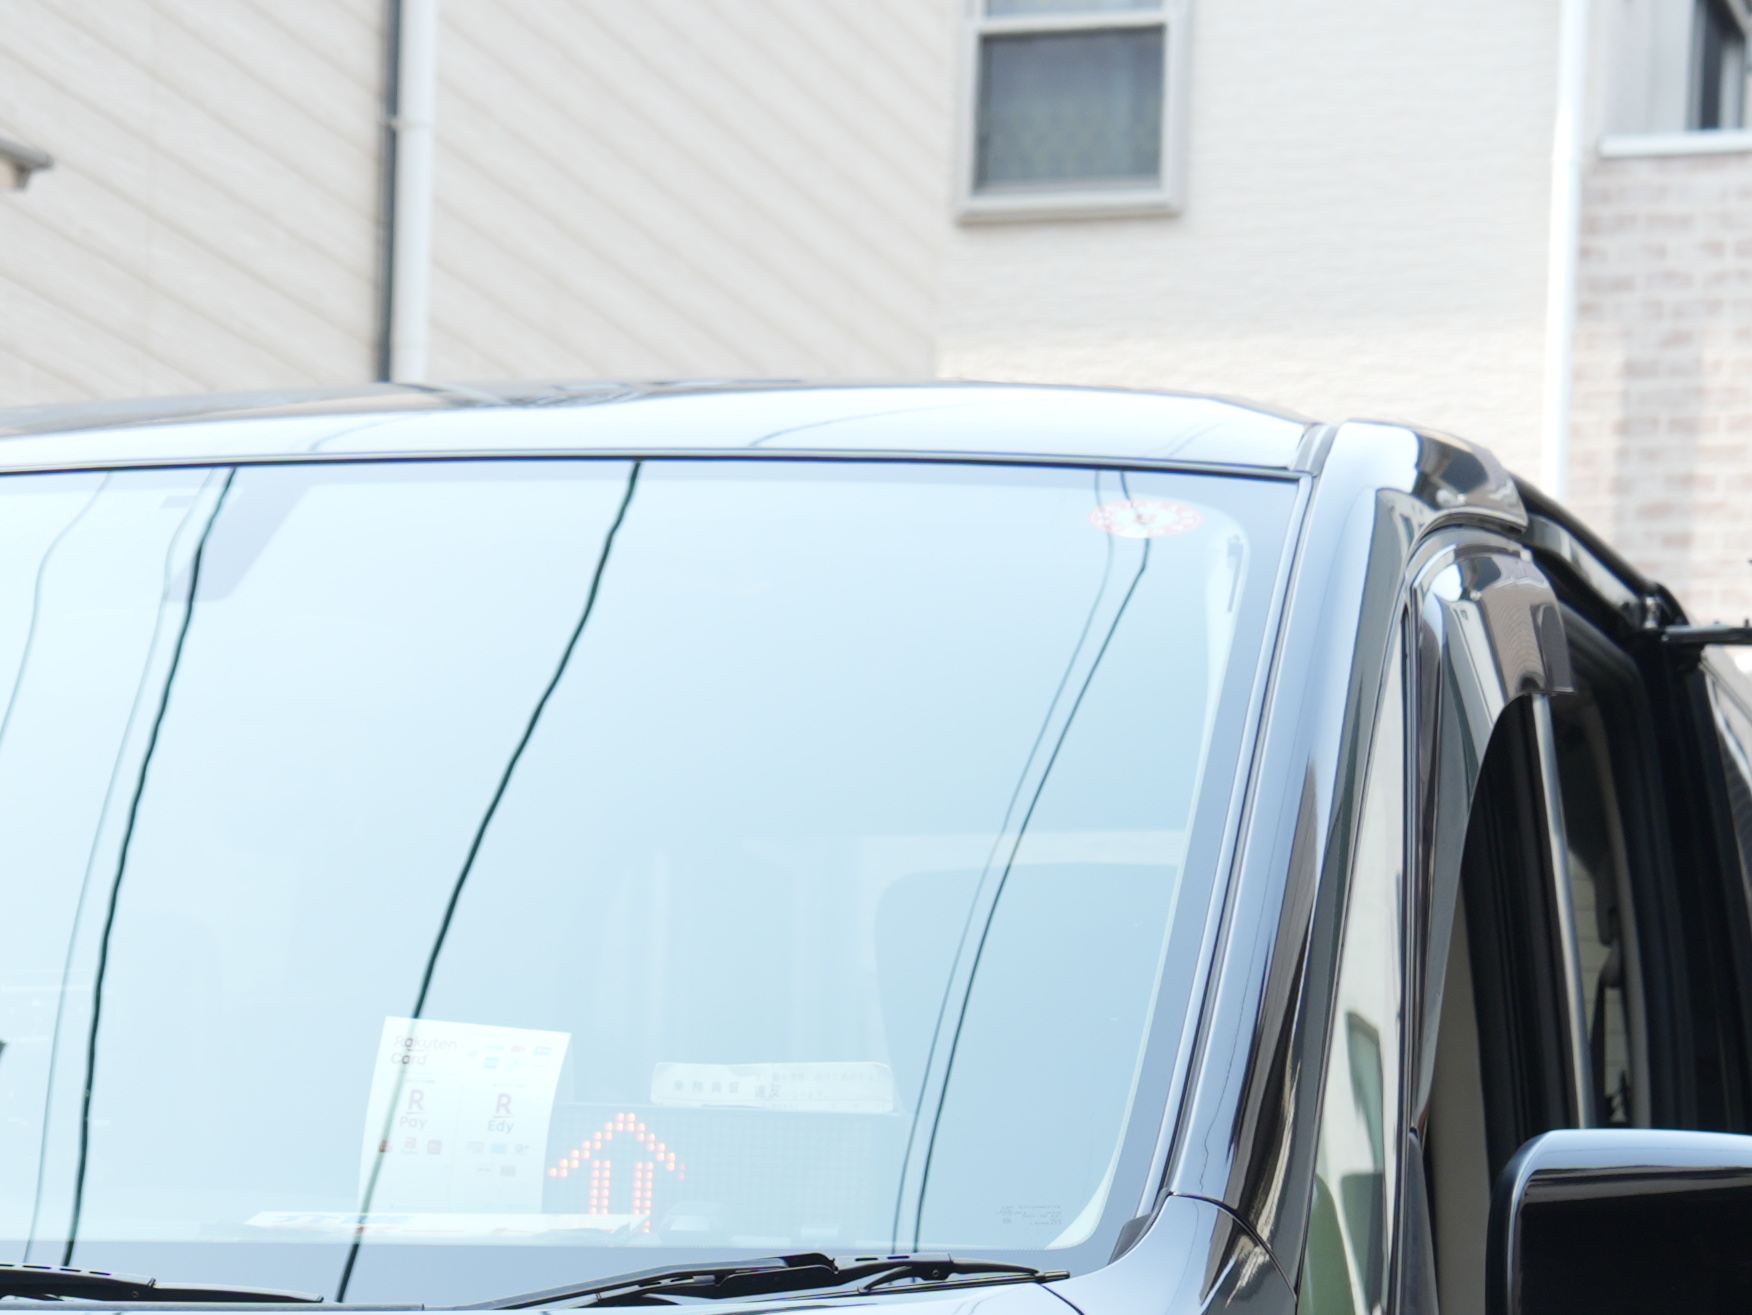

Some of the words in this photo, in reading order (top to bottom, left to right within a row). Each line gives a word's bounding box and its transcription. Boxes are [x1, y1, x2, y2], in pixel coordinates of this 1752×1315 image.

[394, 1035, 457, 1050] Rakuten
[390, 1053, 428, 1065] Card
[408, 1089, 424, 1110] R
[495, 1093, 512, 1114] R
[399, 1116, 428, 1130] Pay
[487, 1119, 515, 1135] Edy
